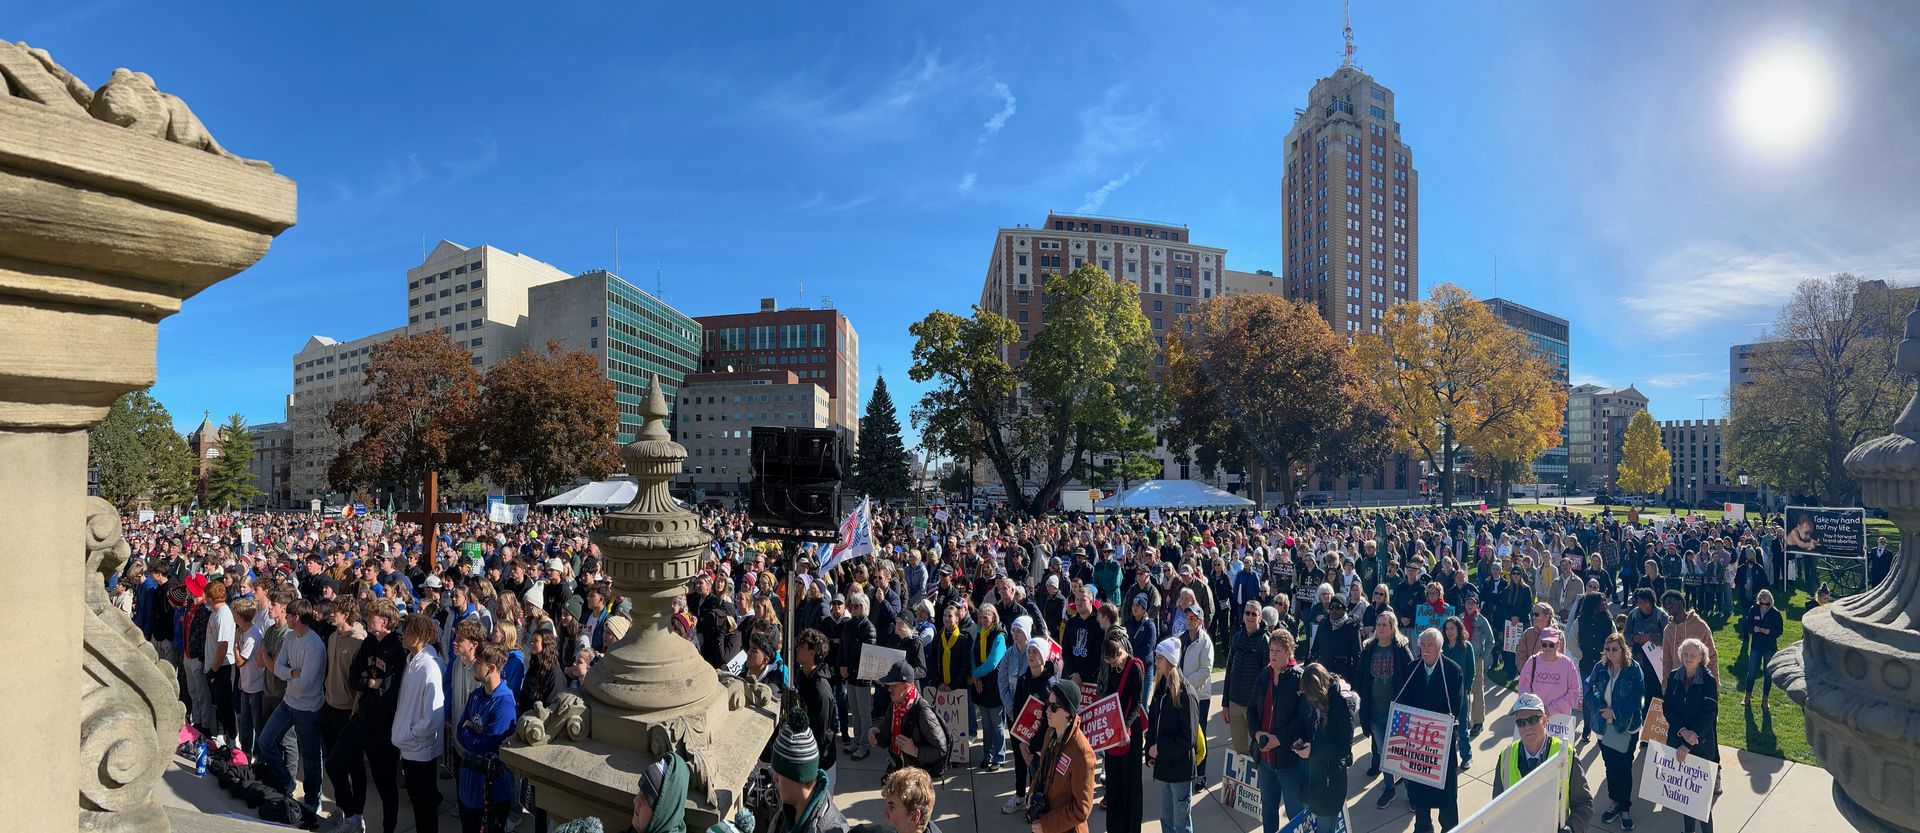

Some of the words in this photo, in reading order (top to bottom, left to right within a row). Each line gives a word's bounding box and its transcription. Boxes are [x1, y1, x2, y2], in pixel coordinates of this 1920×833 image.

[1813, 515, 1830, 524] Take
[1840, 516, 1861, 524] hand
[1838, 524, 1851, 532] life
[1081, 710, 1093, 723] AND
[1093, 701, 1116, 718] RAPIDS
[1083, 716, 1108, 735] LOVES
[1396, 713, 1440, 750] Life
[1547, 722, 1569, 736] orgive
[1391, 745, 1439, 766] INALIENABLE
[1424, 745, 1439, 754] first
[1408, 761, 1433, 774] RIGHT
[1653, 751, 1676, 771] Lord,
[1678, 762, 1709, 781] Forgive
[1655, 767, 1666, 781] Us
[1666, 774, 1684, 786] and
[1684, 778, 1703, 794] Our
[1661, 784, 1690, 806] Nation
